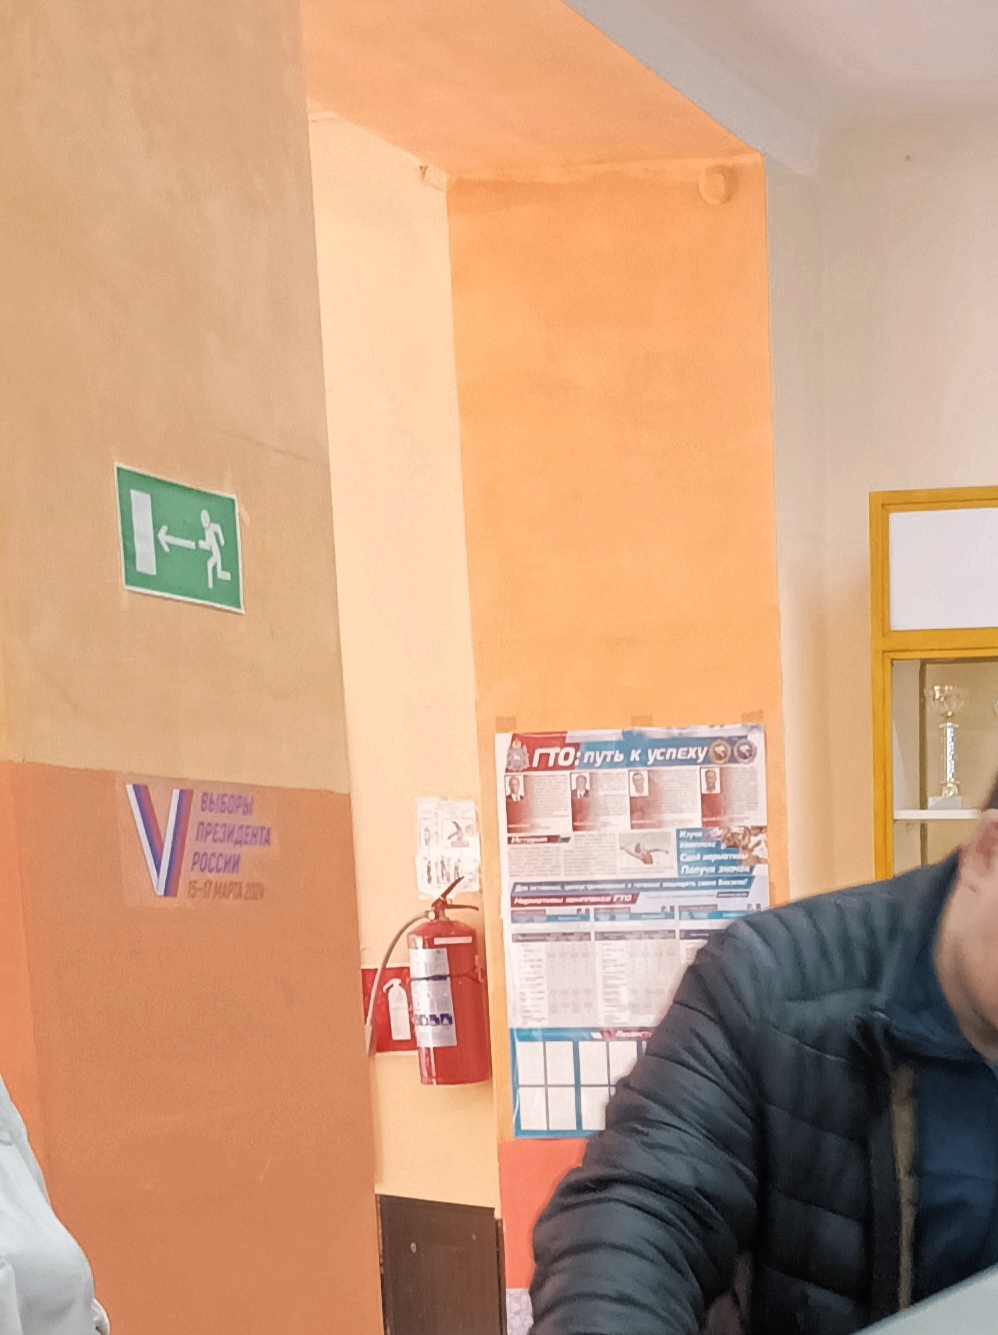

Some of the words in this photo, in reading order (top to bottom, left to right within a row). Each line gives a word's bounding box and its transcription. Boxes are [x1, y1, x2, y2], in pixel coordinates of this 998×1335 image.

[532, 746, 581, 767] ГТО:
[583, 749, 624, 768] путь
[630, 750, 642, 761] к
[647, 746, 708, 764] успеху
[200, 792, 254, 816] ВЫБОРЫ
[195, 821, 272, 847] ПРЕЗИДЕНТА
[191, 852, 241, 874] РОССИИ
[214, 881, 243, 900] МАРТА
